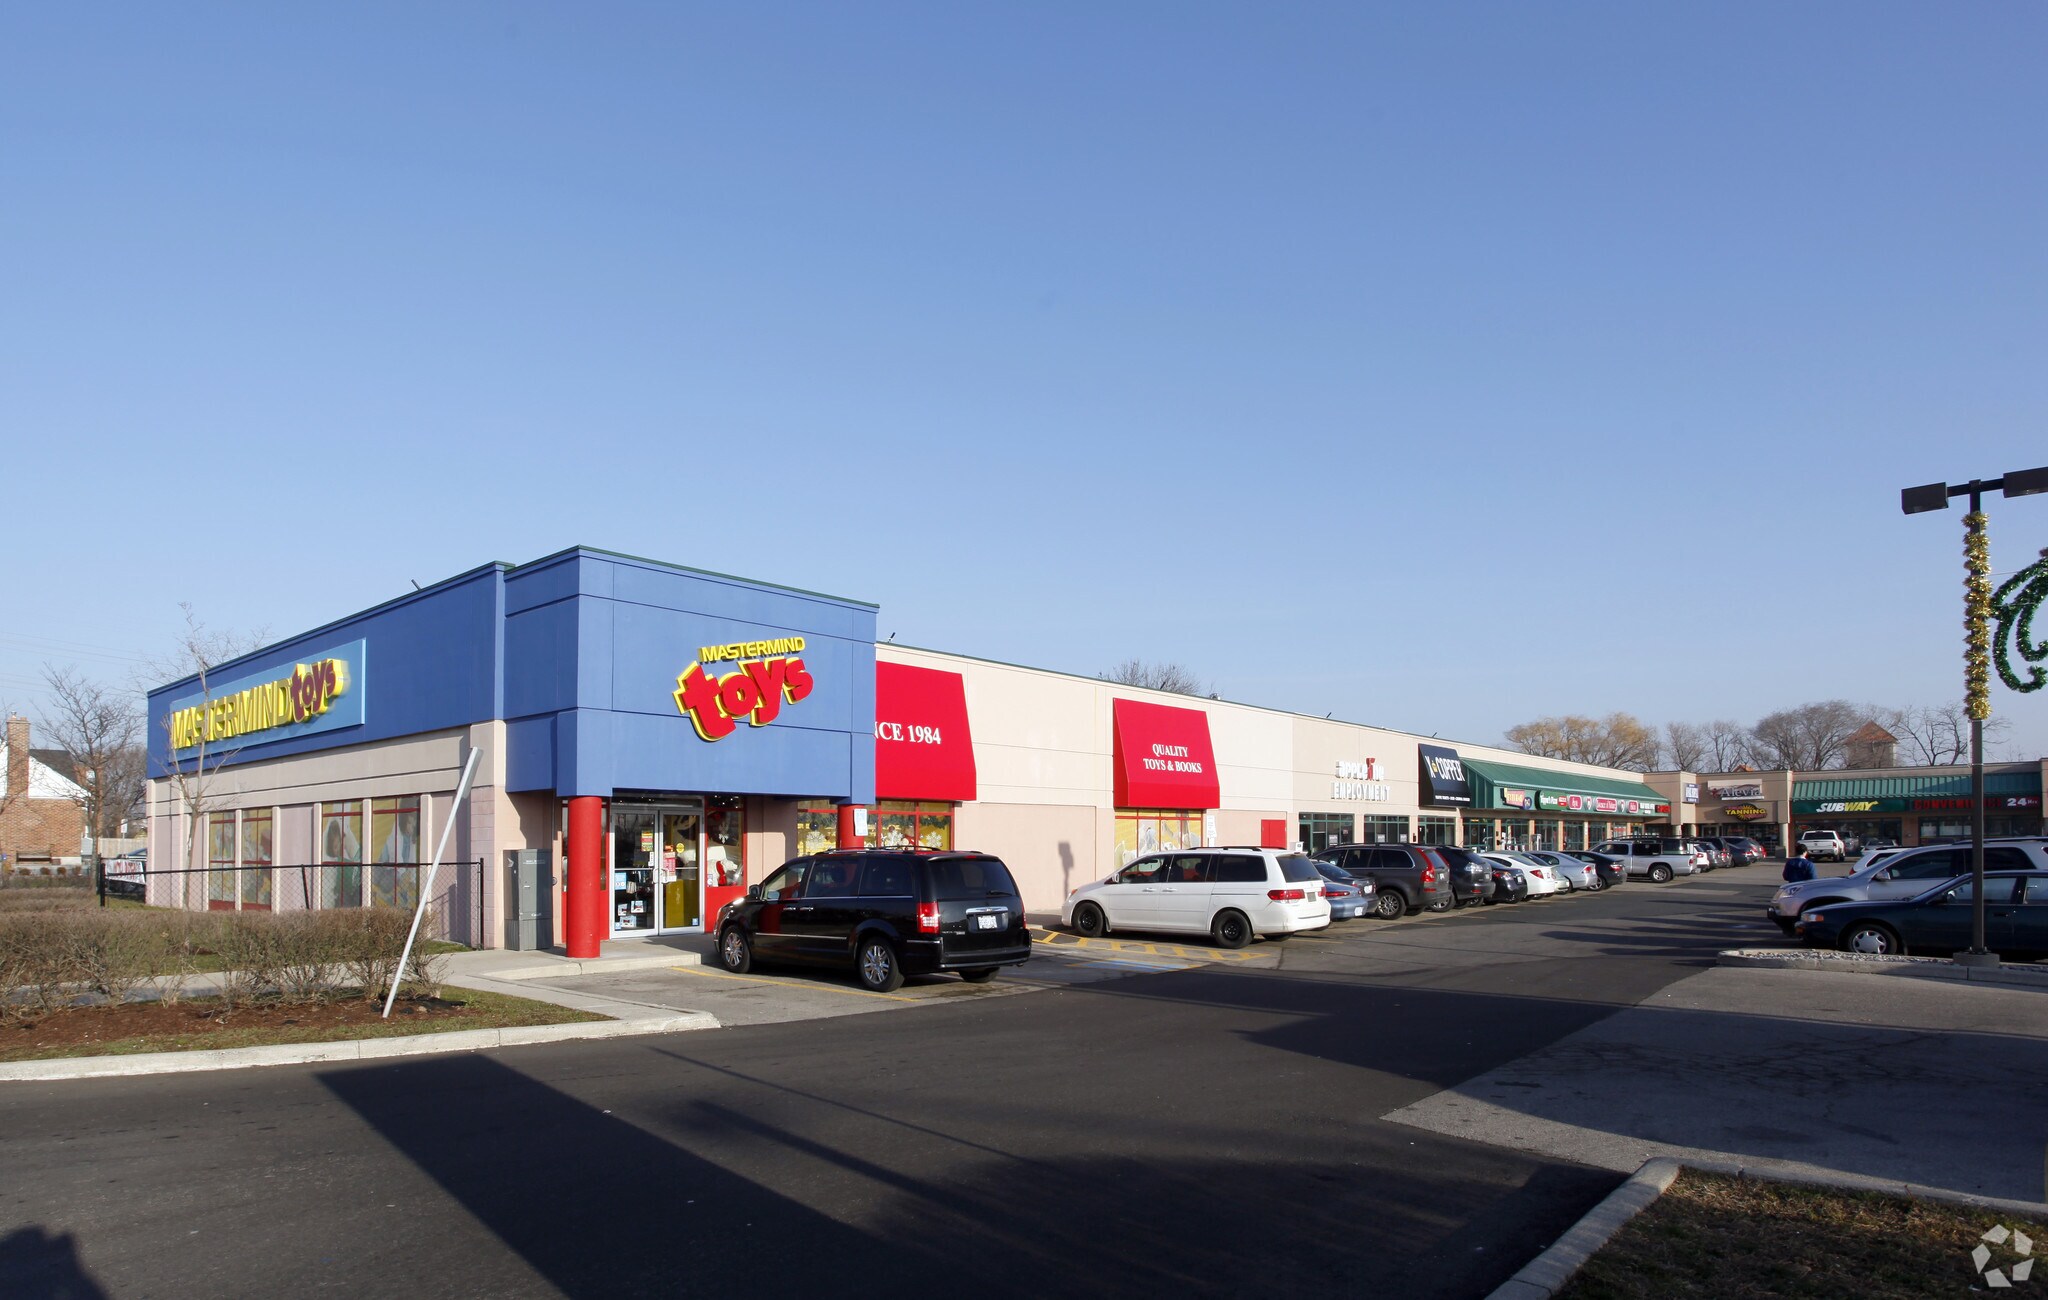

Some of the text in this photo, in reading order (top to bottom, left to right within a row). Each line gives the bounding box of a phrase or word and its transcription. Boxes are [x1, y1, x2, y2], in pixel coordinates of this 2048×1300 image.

[698, 637, 806, 662] MASTERMIND
[172, 658, 345, 749] MASTERMIND toys
[672, 656, 814, 742] toys
[907, 724, 942, 745] 1984
[1152, 743, 1188, 758] QUALITY
[1142, 757, 1202, 773] TOYS & BOOKS
[1331, 782, 1391, 801] EMPLOYMENT
[1720, 786, 1761, 797] Alevia
[1815, 801, 1879, 813] SUBWAY
[2007, 797, 2027, 807] 24
[1725, 808, 1766, 816] TANNING
